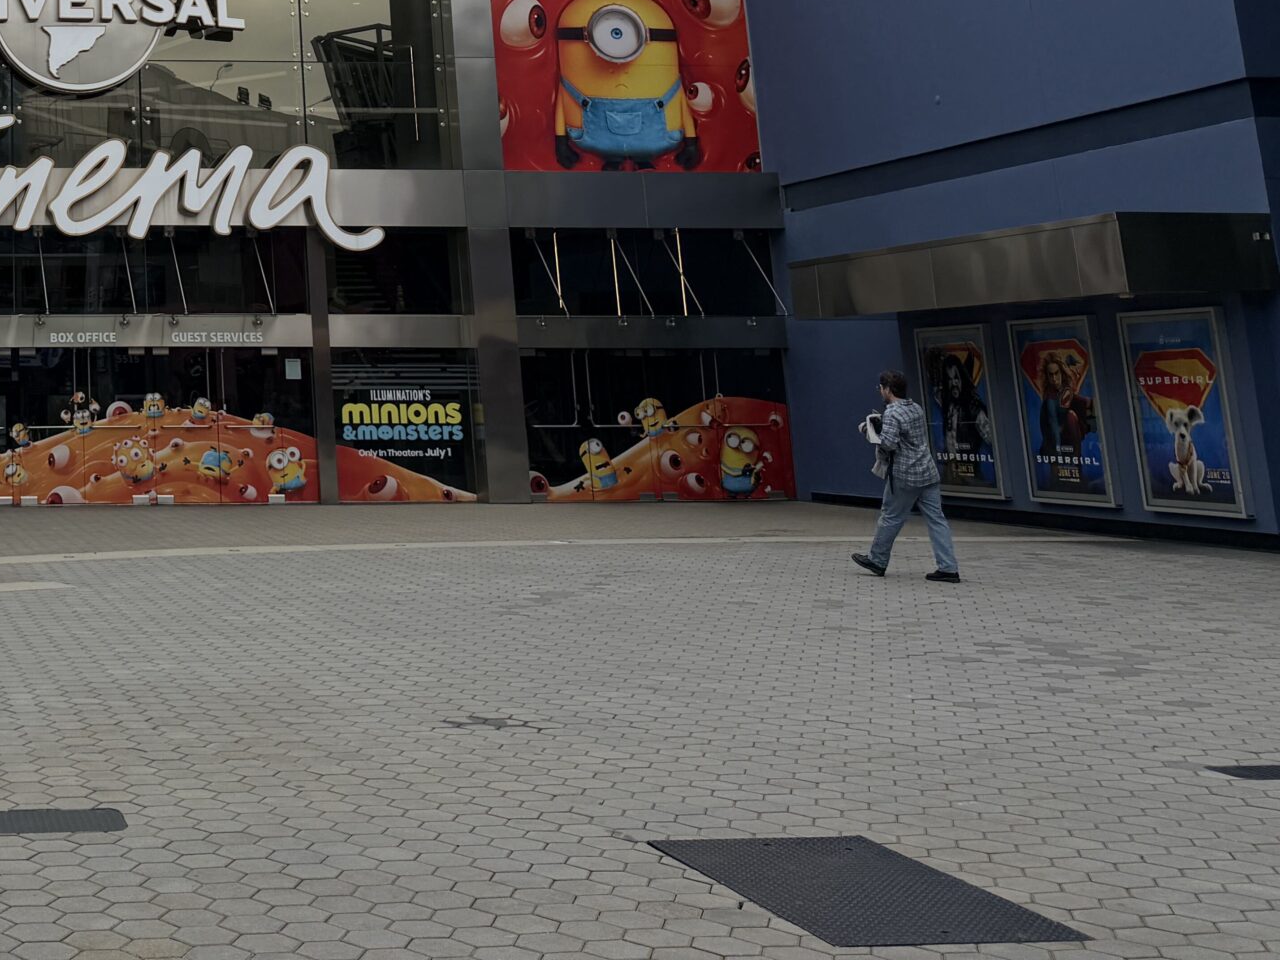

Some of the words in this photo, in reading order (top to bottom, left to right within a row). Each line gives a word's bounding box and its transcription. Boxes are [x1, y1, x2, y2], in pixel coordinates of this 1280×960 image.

[50, 332, 74, 343] BOX
[76, 332, 117, 343] OFFICE
[171, 332, 207, 343] GUEST
[209, 332, 263, 343] SERVICES
[1138, 375, 1214, 385] SUPERGIRL
[370, 389, 431, 401] ILLUMINATION'S
[341, 402, 462, 425] minions
[358, 448, 379, 460] Only
[388, 448, 424, 457] Theaters
[424, 447, 446, 460] July
[447, 448, 452, 457] 1
[936, 452, 994, 463] SUPERGIRL
[1036, 454, 1100, 466] SUPERGIRL
